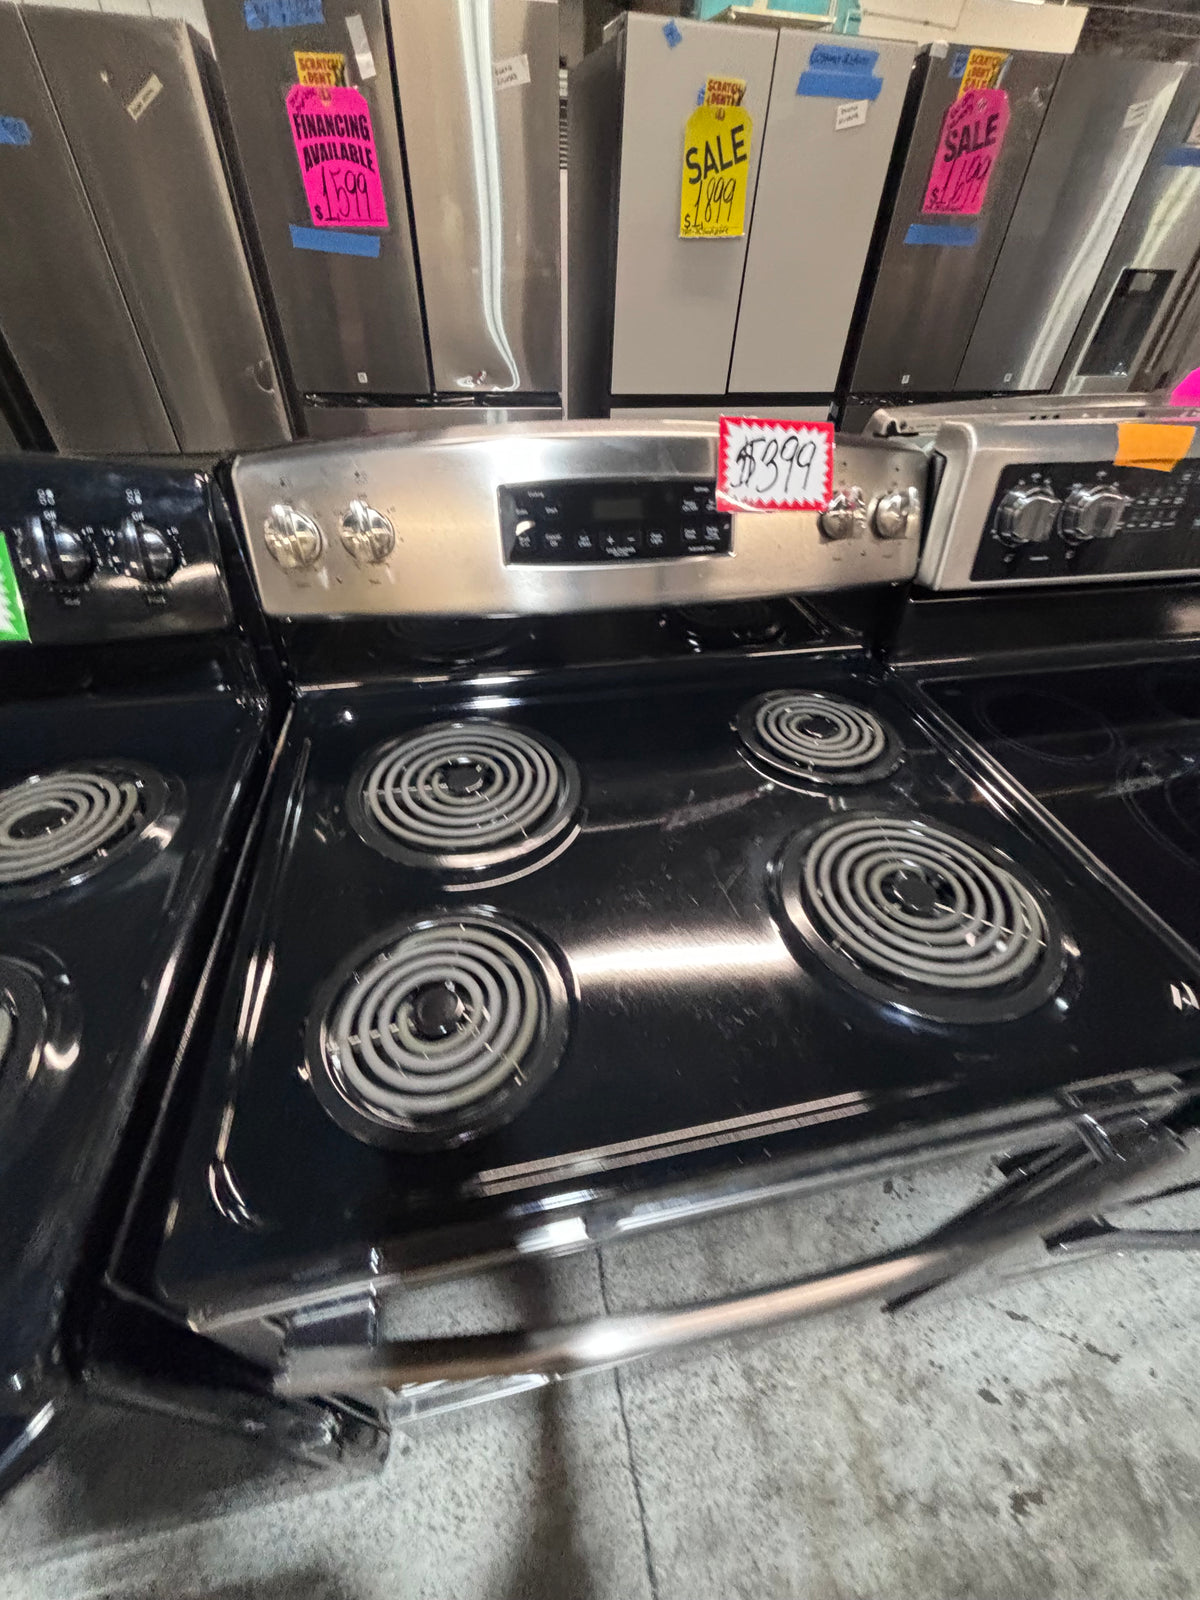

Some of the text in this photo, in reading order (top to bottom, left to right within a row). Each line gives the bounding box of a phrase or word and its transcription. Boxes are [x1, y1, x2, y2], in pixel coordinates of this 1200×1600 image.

[292, 113, 371, 142] FINANCING
[943, 113, 999, 162] SALE
[303, 142, 375, 173] AVAILABLE
[685, 123, 748, 185] SALE
[730, 435, 817, 493] $399
